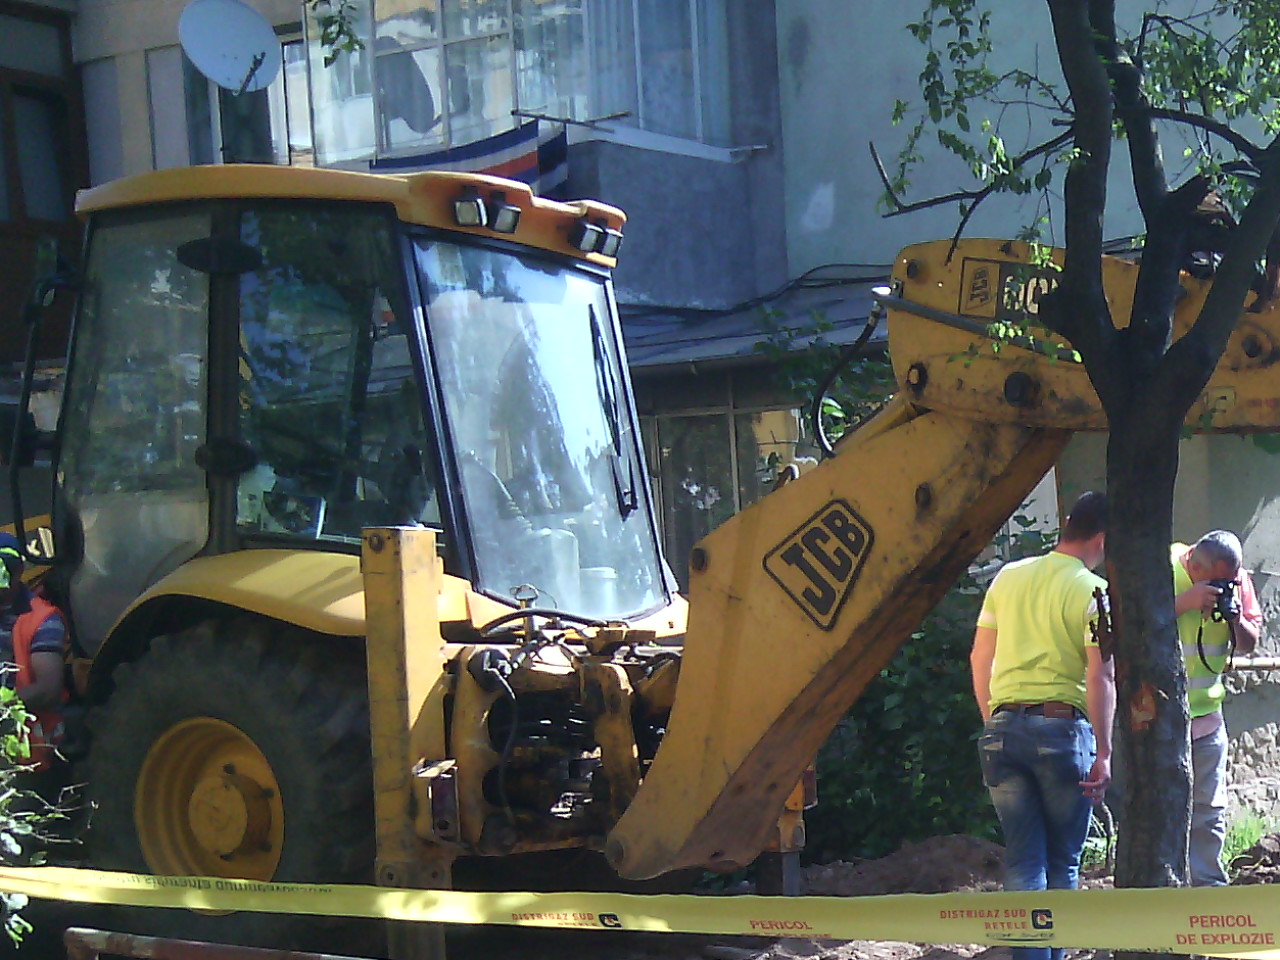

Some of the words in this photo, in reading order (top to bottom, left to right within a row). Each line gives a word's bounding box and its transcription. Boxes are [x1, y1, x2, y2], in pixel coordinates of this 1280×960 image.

[780, 509, 865, 616] JCB
[511, 912, 569, 922] DISTRIGAZ
[572, 912, 595, 922] SUD
[939, 909, 1000, 919] DISTRIGAZ
[1003, 908, 1027, 918] SUD
[748, 919, 813, 930] PERICOL
[984, 921, 1028, 930] RETELE
[1189, 914, 1257, 928] PERICOL
[1175, 933, 1198, 946] DE
[1200, 932, 1276, 946] EXPLOZIE
